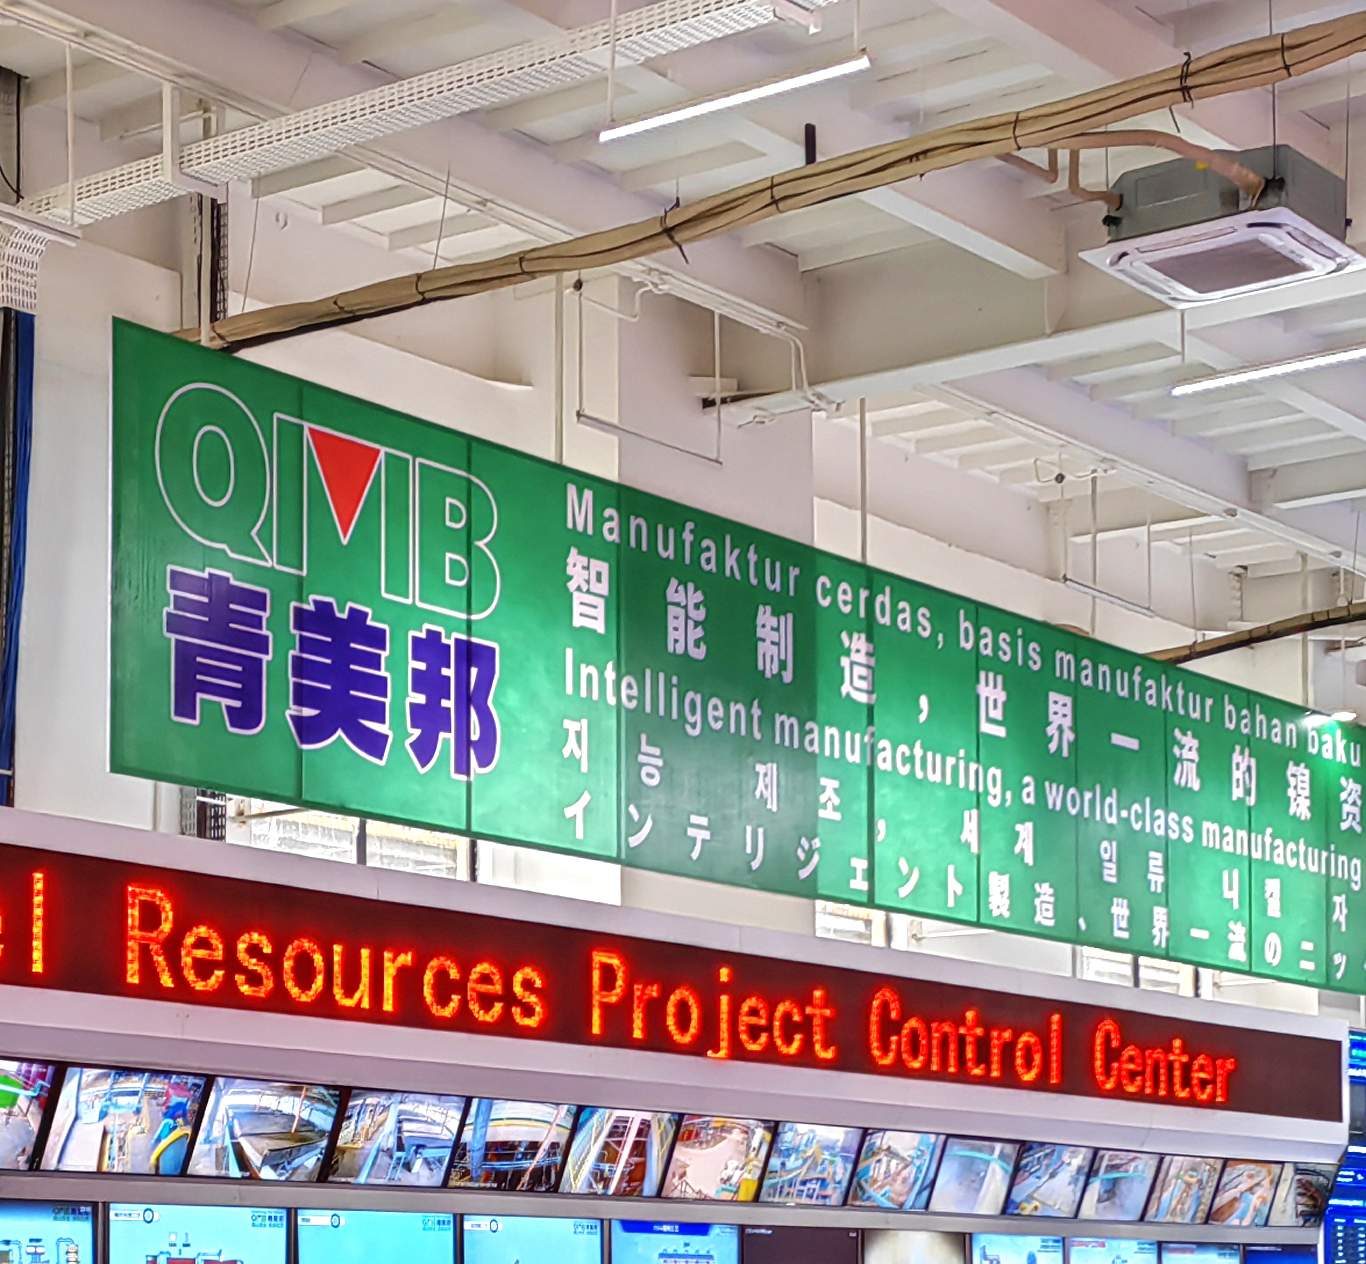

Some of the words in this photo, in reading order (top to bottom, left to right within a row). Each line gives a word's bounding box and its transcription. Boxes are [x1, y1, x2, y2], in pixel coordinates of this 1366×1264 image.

[155, 382, 502, 620] QMB
[164, 564, 502, 782] 青美邦
[566, 483, 800, 597] Manufaktur
[815, 575, 944, 649] cerdas,
[959, 609, 1042, 671] basis
[1055, 650, 1213, 723] manufaktur
[1224, 694, 1298, 750] bahan
[1308, 724, 1361, 767] baku
[562, 719, 664, 787] 지능
[961, 809, 1034, 866] 세계
[565, 647, 762, 740] Intelligent
[774, 712, 1012, 807] manufacturing,
[1021, 775, 1036, 805] a
[1044, 782, 1195, 843] world-class
[1202, 820, 1361, 891] manufacturing
[125, 884, 545, 1028] Resources
[591, 949, 836, 1059] Project
[869, 986, 1062, 1086] Control
[1094, 1018, 1237, 1105] Center
